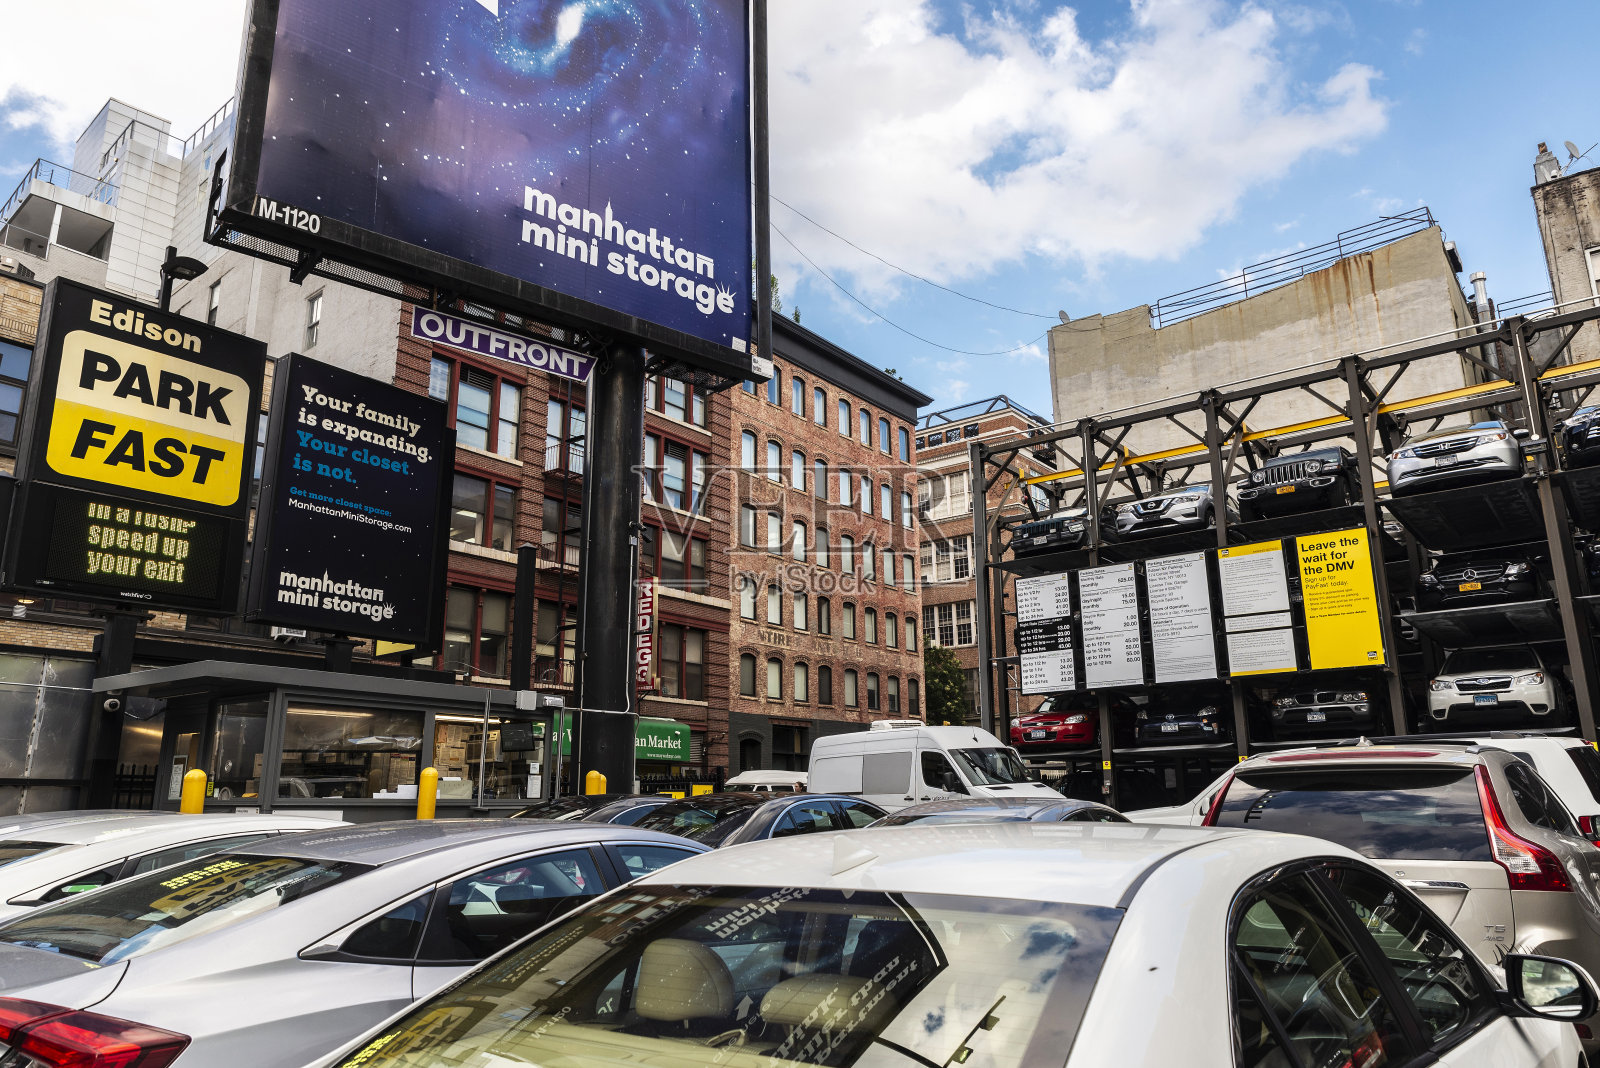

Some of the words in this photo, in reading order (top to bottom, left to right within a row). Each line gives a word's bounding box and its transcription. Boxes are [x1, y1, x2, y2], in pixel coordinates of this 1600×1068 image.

[259, 198, 320, 234] M-1120
[524, 185, 714, 279] manhattan
[522, 220, 598, 266] mini
[606, 251, 737, 315] storage
[90, 298, 202, 354] Edison
[420, 312, 589, 379] OUTFRONT
[78, 348, 232, 426] PARK
[301, 384, 353, 414] Your
[356, 400, 422, 438] family
[70, 418, 226, 486] FAST
[296, 429, 350, 460] Your
[351, 444, 410, 476] closet
[298, 406, 318, 427] is
[321, 414, 434, 463] expanding.
[292, 452, 312, 472] is
[316, 462, 358, 485] not.
[116, 507, 130, 524] a
[288, 498, 412, 534] ManhattanMiniStorage.com
[290, 486, 306, 498] Get
[309, 492, 334, 503] more
[336, 498, 362, 510] closet
[364, 505, 392, 516] space:
[88, 524, 158, 554] speed
[162, 536, 190, 560] up
[1301, 541, 1336, 552] Leave
[1340, 537, 1359, 546] the
[1302, 552, 1327, 564] wait
[1330, 551, 1347, 560] for
[87, 550, 141, 576] your
[144, 559, 185, 583] exit
[1304, 566, 1322, 575] the
[1326, 560, 1354, 572] DMV
[280, 568, 384, 602] manhattan
[278, 588, 319, 608] mini
[322, 596, 396, 622] storage
[648, 734, 682, 749] Market
[1484, 925, 1506, 933] T5
